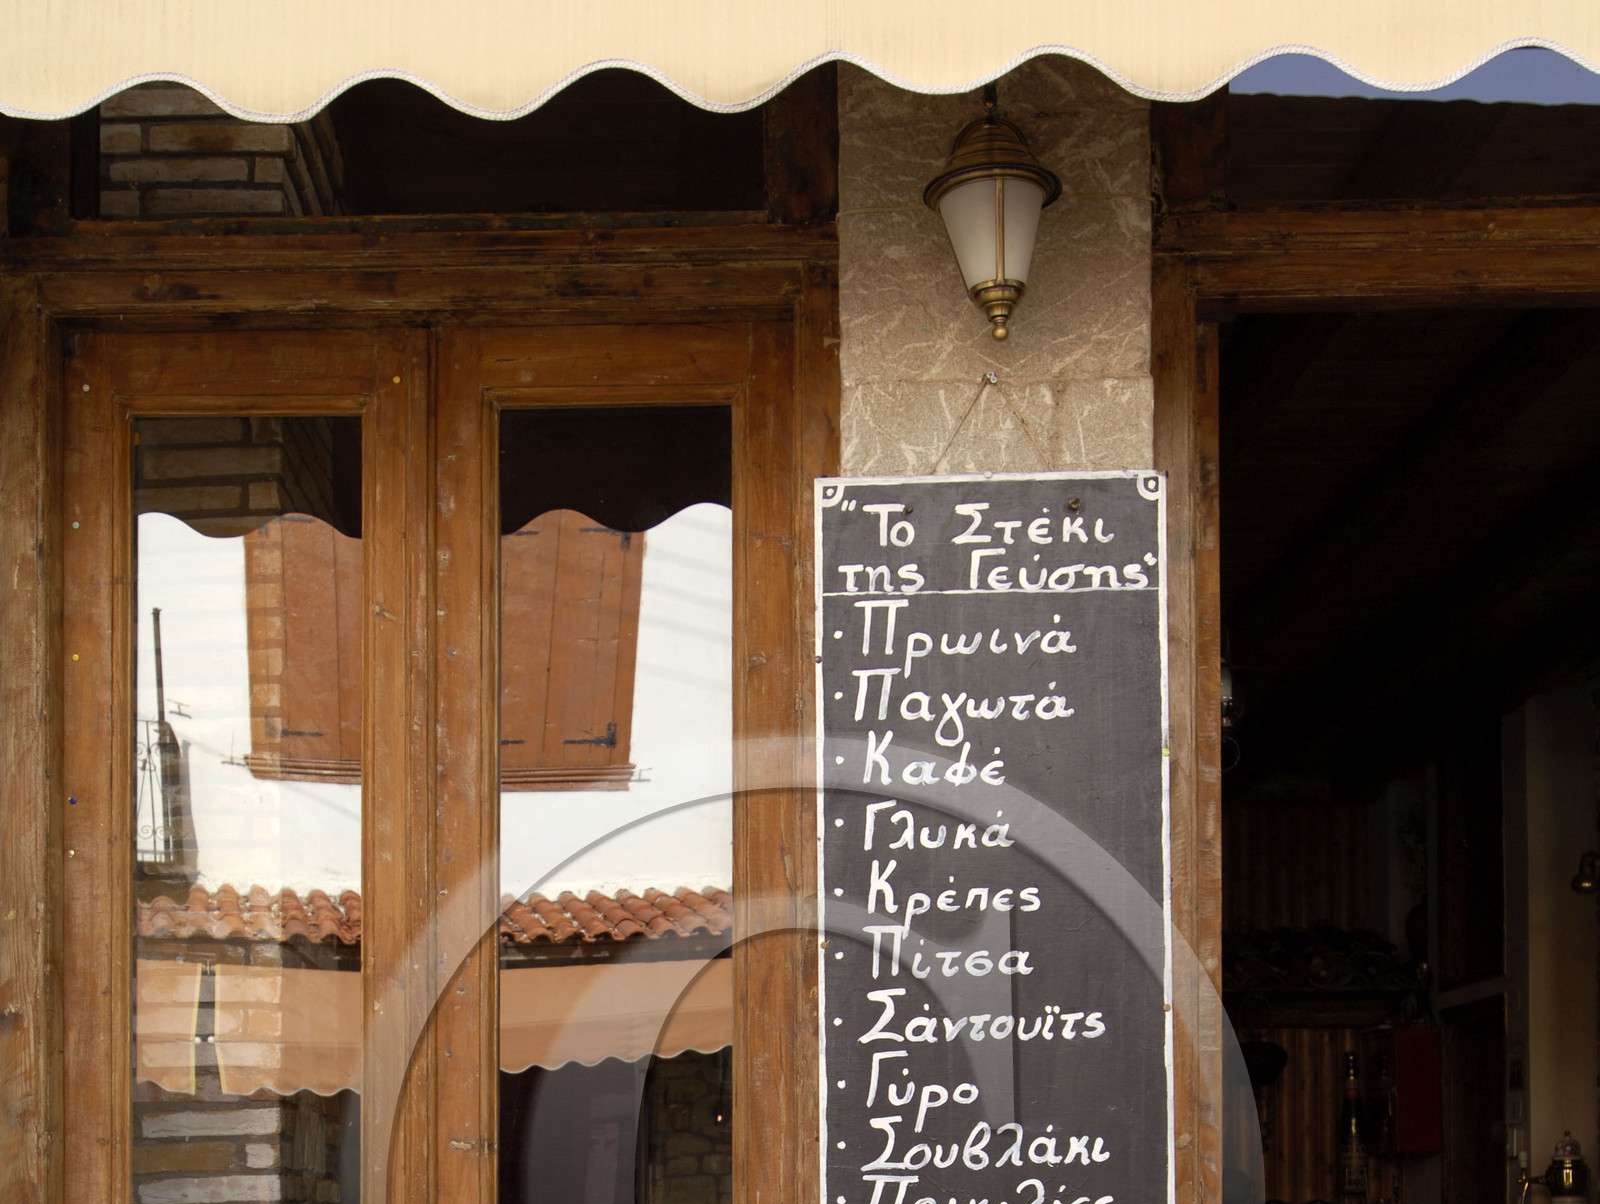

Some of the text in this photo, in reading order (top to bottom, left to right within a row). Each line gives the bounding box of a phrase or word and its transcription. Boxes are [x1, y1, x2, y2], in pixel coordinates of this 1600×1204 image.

[951, 502, 1115, 544] Στέκι
[838, 563, 925, 592] της
[853, 599, 1077, 678] Πρωινά
[851, 667, 1075, 747] Παγωτά
[863, 730, 1006, 787] Καφέ
[863, 799, 1016, 851] Γλυκά
[867, 859, 1041, 940] Κρέπες
[862, 925, 1034, 980] Πίτσα
[866, 1050, 980, 1133] Γύρο
[861, 1115, 1111, 1172] Σουβλάκι
